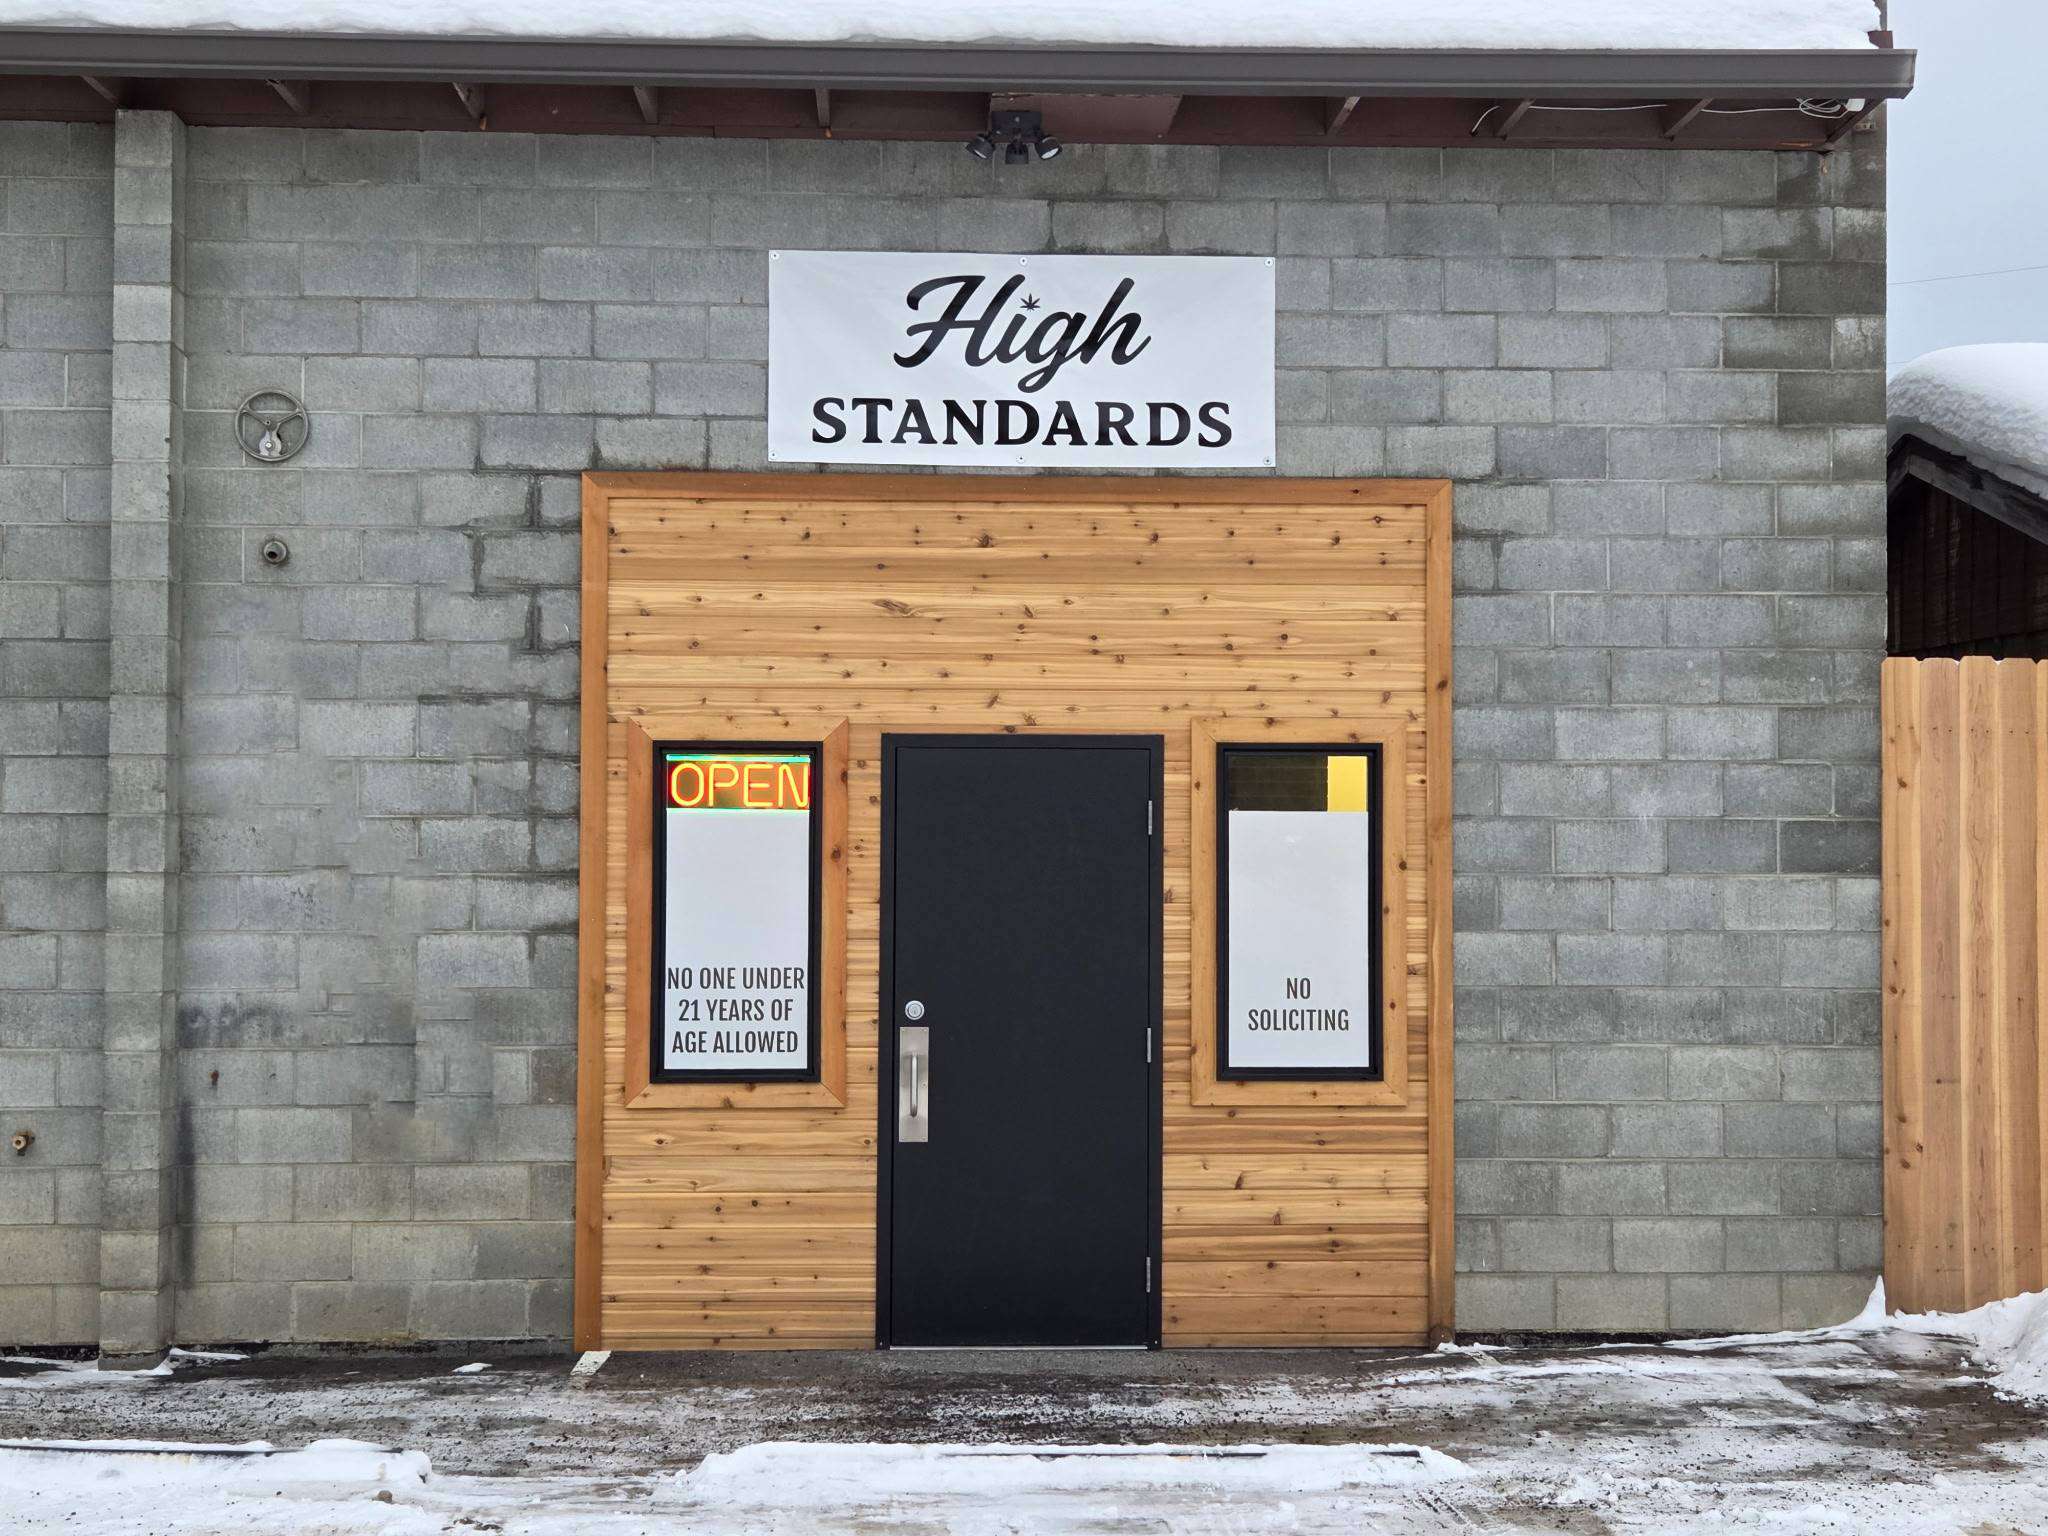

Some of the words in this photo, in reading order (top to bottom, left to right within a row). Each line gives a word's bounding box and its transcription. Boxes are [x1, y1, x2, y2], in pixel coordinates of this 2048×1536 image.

[893, 274, 1151, 393] High
[812, 397, 1232, 447] STANDARDS
[670, 762, 810, 808] OPEN
[667, 967, 693, 989] NO
[699, 967, 736, 989] ONE
[743, 967, 805, 989] UNDER
[1286, 977, 1311, 999] NO
[678, 999, 701, 1021] 21
[706, 999, 765, 1021] YEARS
[771, 999, 794, 1021] OF
[1248, 1009, 1349, 1031] SOLICITING
[672, 1031, 707, 1053] AGE
[712, 1031, 798, 1053] ALLOWED
